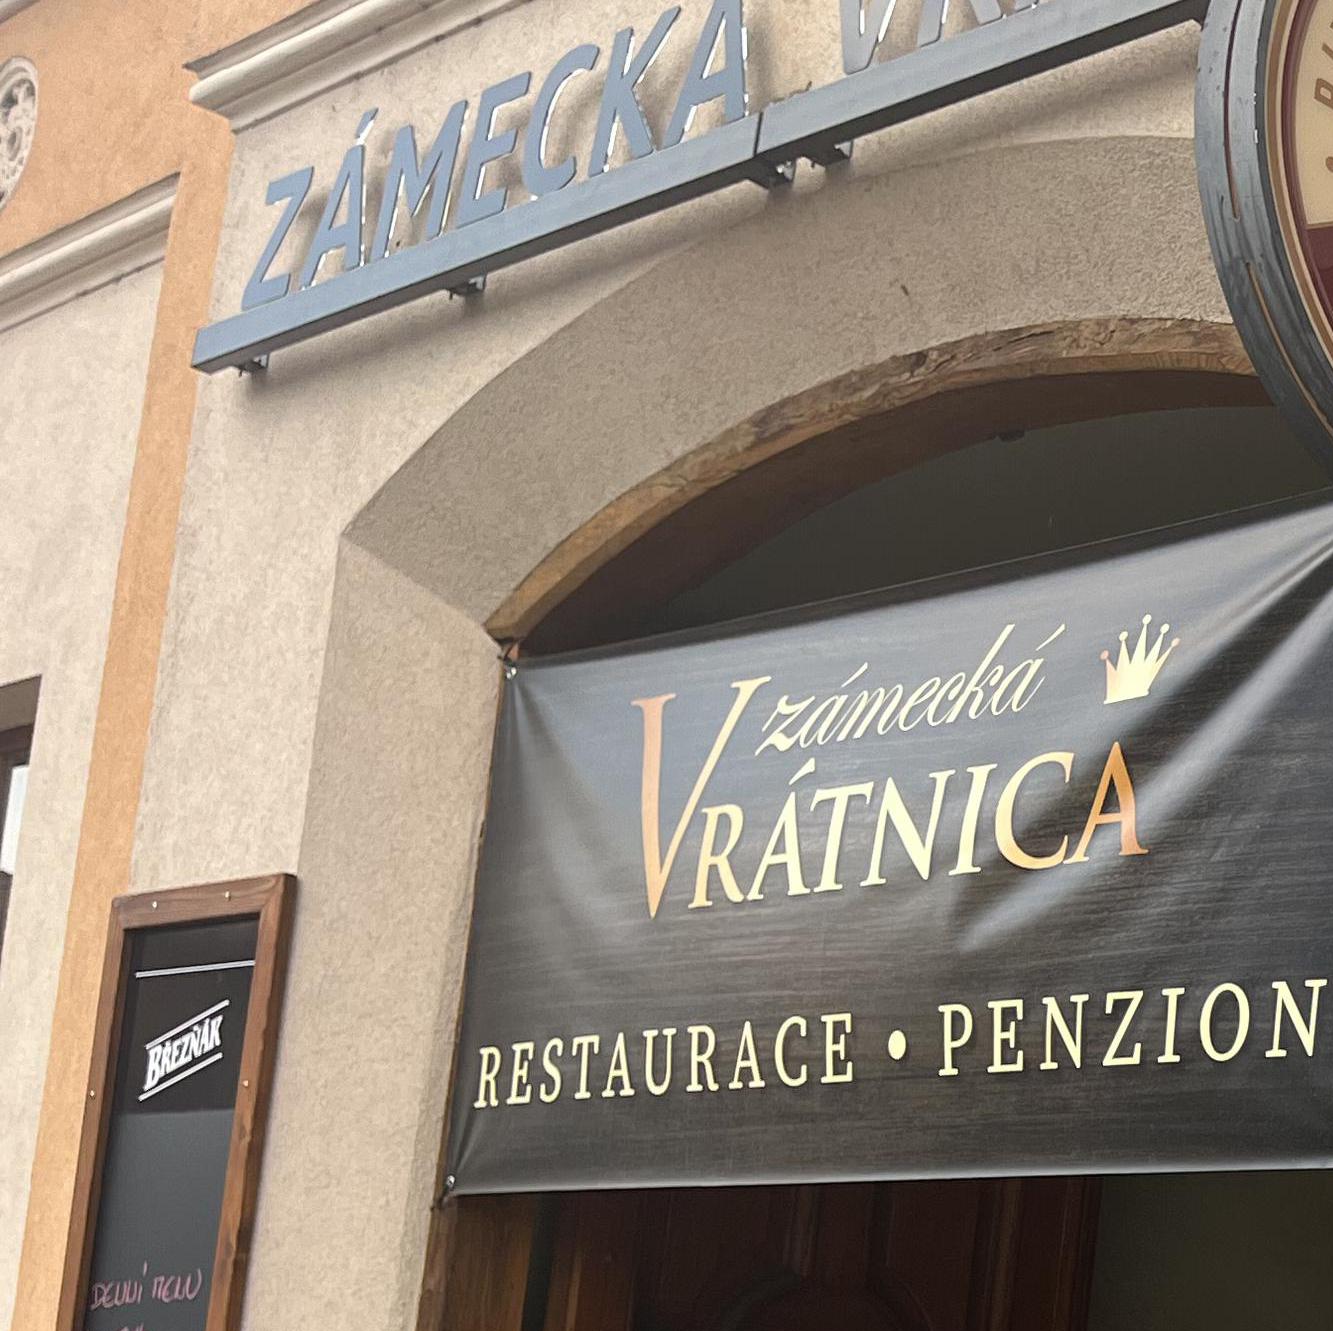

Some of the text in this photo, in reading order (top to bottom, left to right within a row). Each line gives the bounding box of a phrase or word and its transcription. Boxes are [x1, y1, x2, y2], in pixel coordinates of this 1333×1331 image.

[755, 623, 1066, 756] zámecká
[631, 675, 1149, 920] VRÁTNICA
[144, 1013, 224, 1091] BŘEZŇÁK
[473, 978, 1329, 1110] RESTAURACE PENZION
[151, 1267, 203, 1304] MENU
